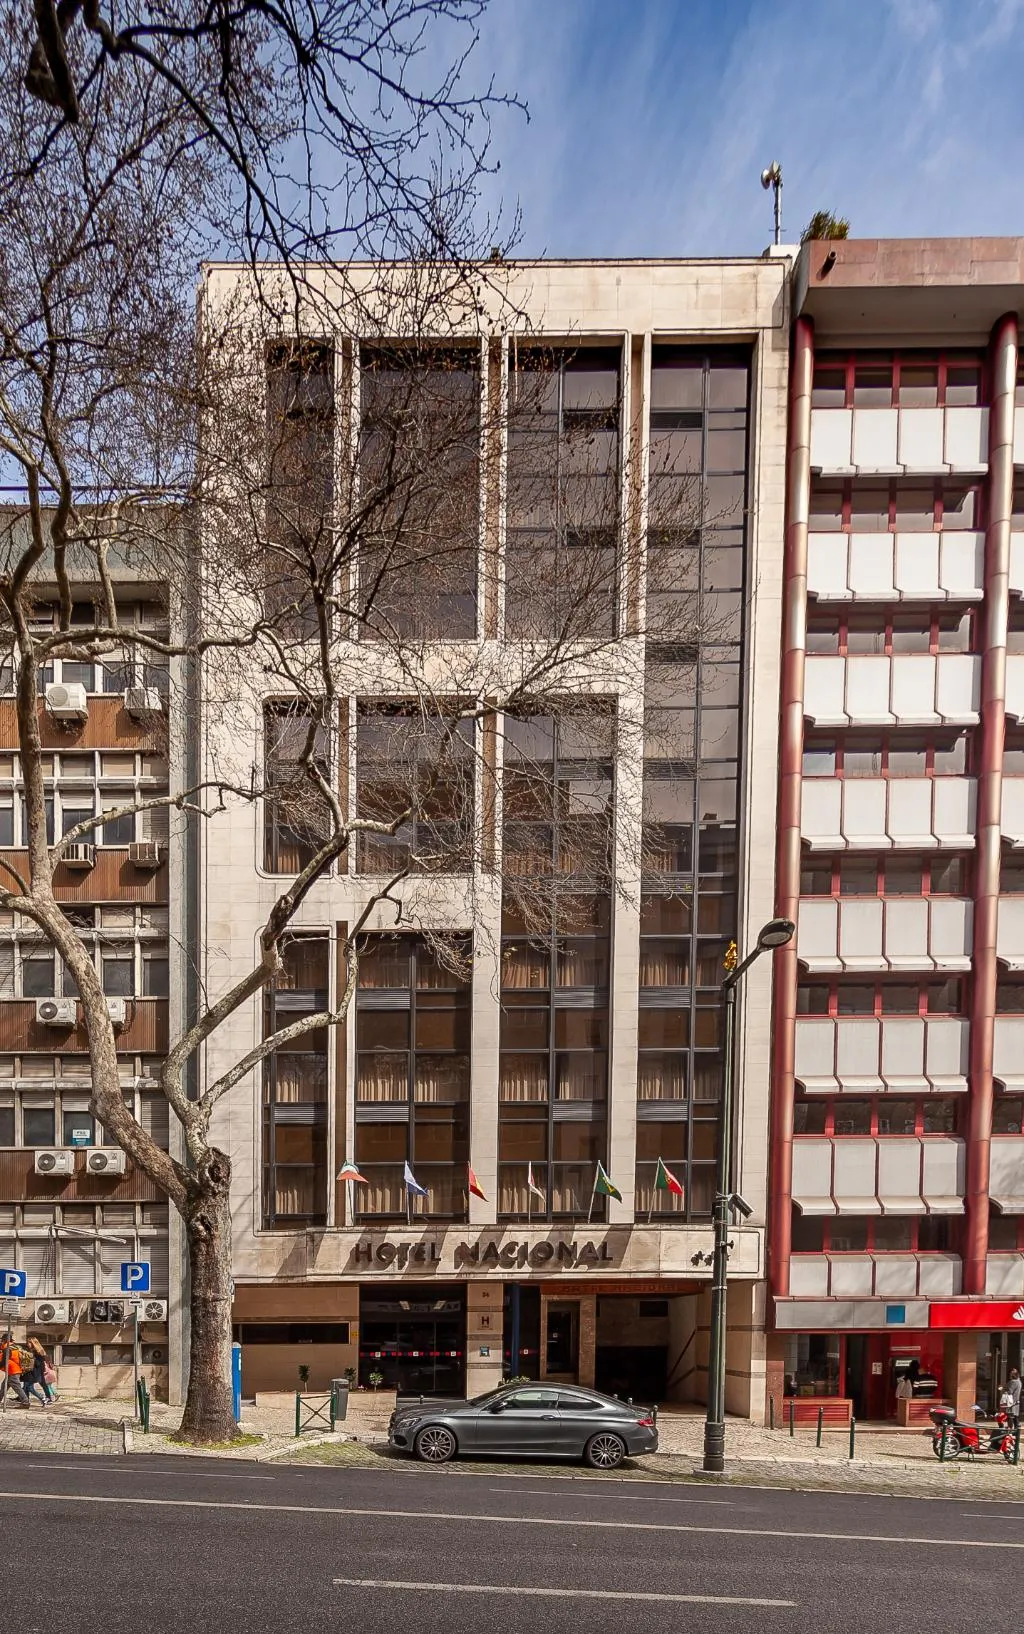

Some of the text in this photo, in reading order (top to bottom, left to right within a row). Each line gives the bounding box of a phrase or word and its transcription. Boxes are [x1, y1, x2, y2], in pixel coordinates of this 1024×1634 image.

[354, 1241, 614, 1266] HOTEL NACIONAL
[4, 1273, 21, 1293] P
[127, 1265, 144, 1289] P
[481, 1316, 490, 1326] H
